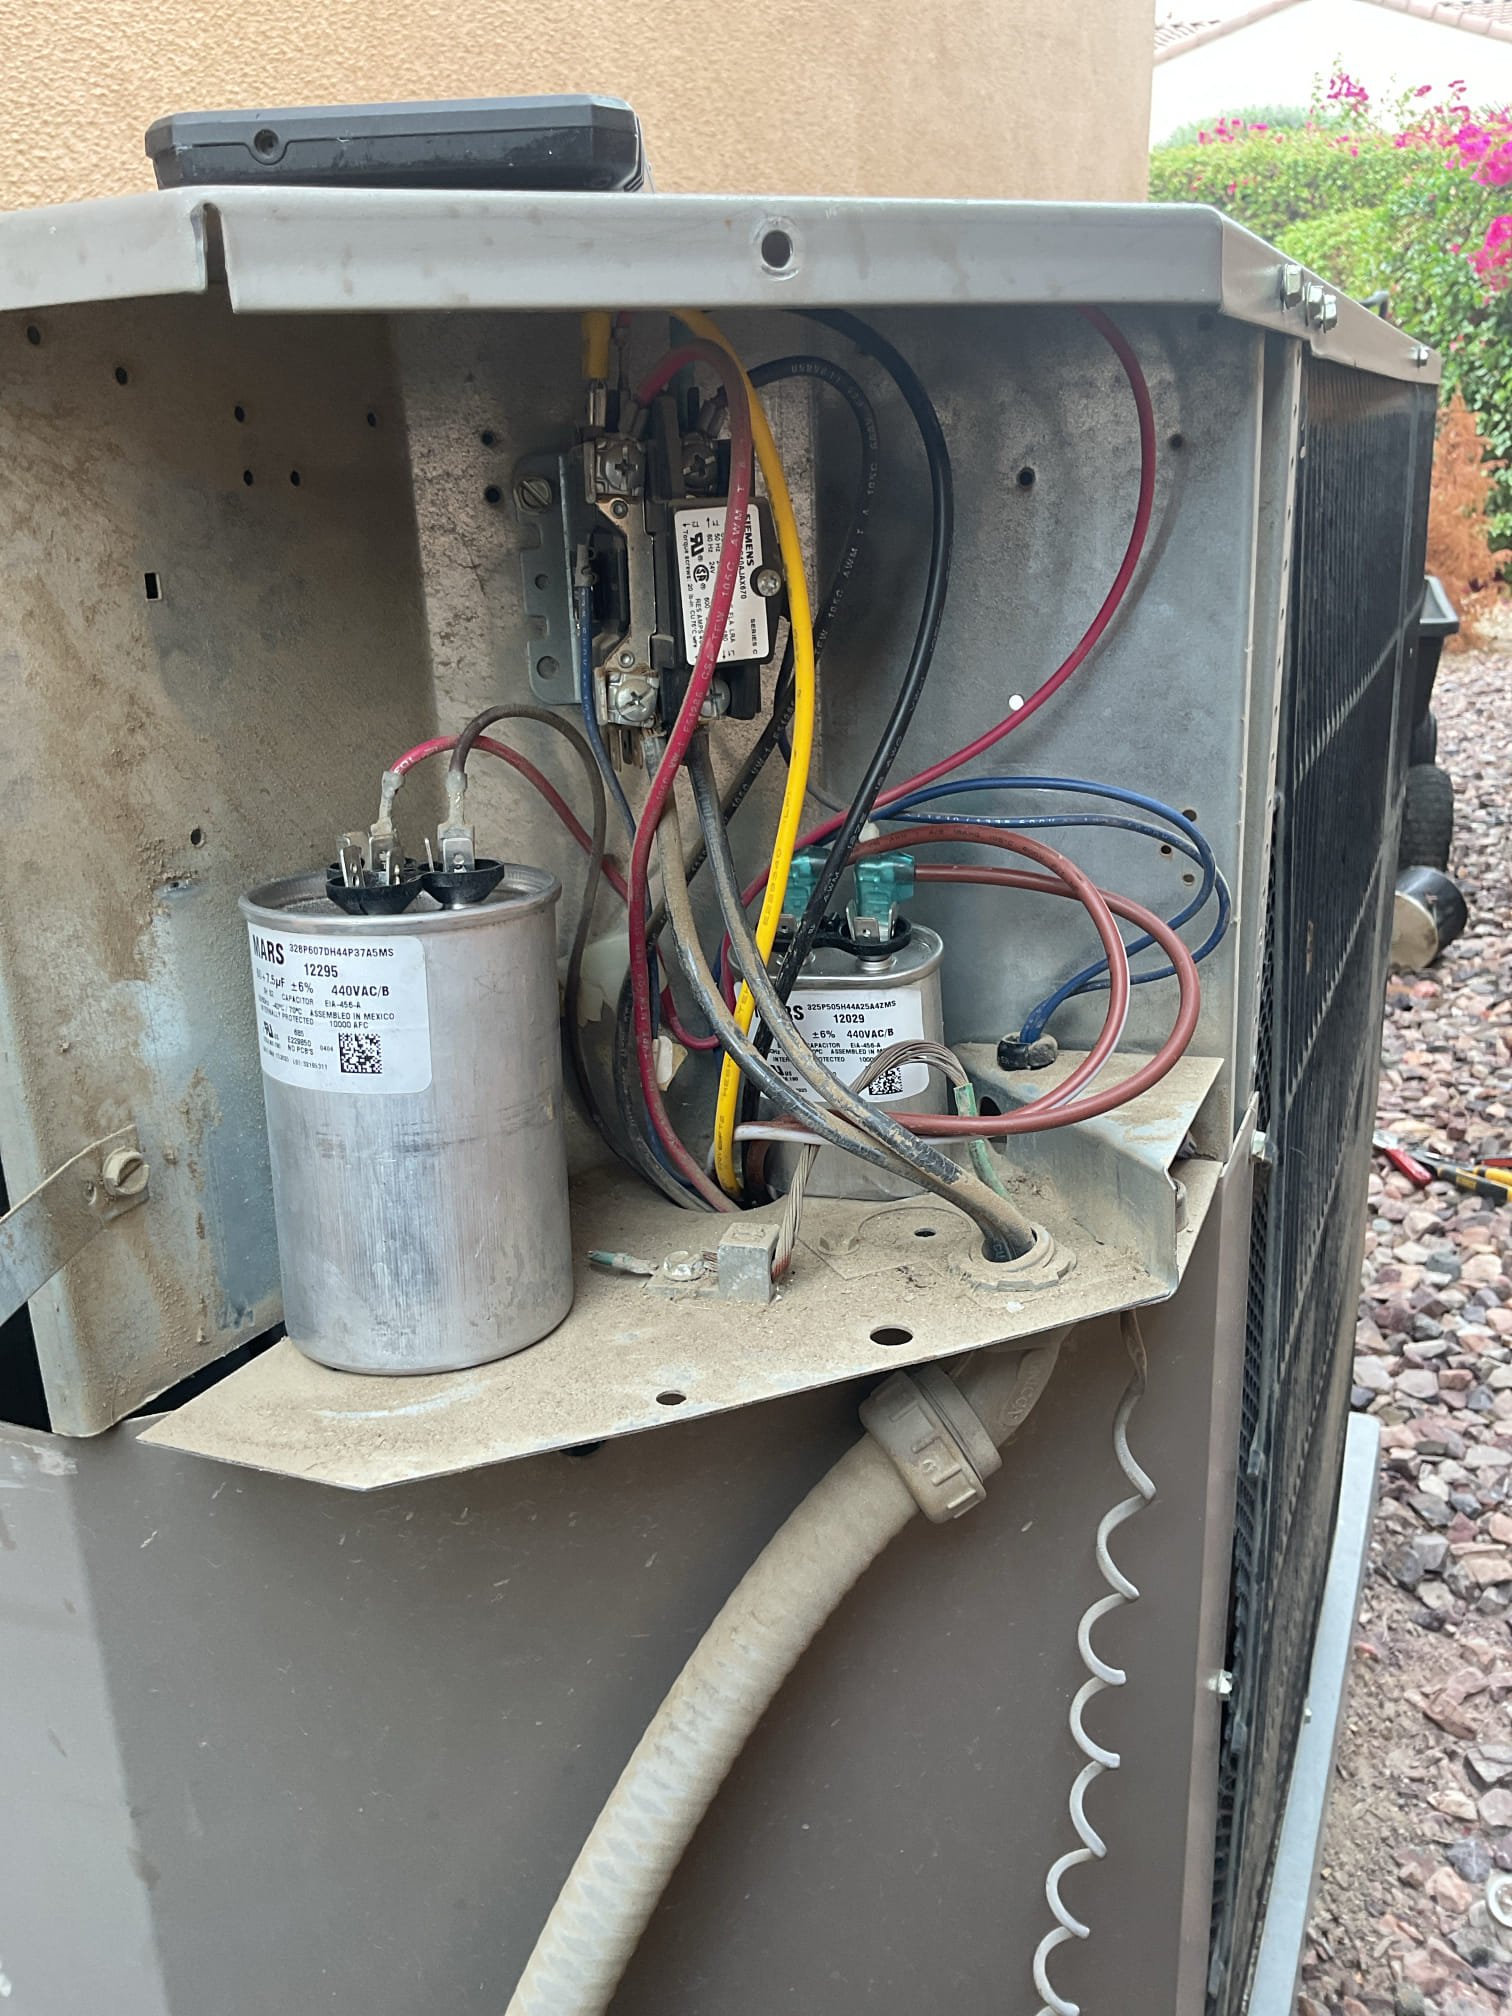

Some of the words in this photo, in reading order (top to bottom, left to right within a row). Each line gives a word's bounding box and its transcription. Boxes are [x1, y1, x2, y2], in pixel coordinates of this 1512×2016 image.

[714, 533, 721, 541] 50
[745, 514, 755, 567] SIEMENS
[707, 544, 713, 553] Hz
[715, 543, 721, 552] Hz
[721, 561, 731, 597] 105C
[730, 509, 742, 546] AWM
[843, 548, 858, 578] AWM
[690, 610, 696, 619] CU
[253, 934, 285, 965] MARS
[304, 963, 339, 978] 12295
[291, 981, 314, 994] ±6%
[331, 985, 390, 997] 440VAC/B
[281, 993, 314, 1006] CAPACITOR
[281, 1012, 314, 1026] PROTECTED
[329, 1020, 351, 1029] 10000
[353, 1021, 369, 1029] AFC
[310, 1010, 351, 1020] ASSEMBLED
[353, 1011, 361, 1020] IN
[363, 1012, 395, 1021] MEXICO
[833, 1014, 865, 1024] 12029
[812, 1030, 836, 1039] ±6%
[847, 1028, 894, 1039] 440VAC/B
